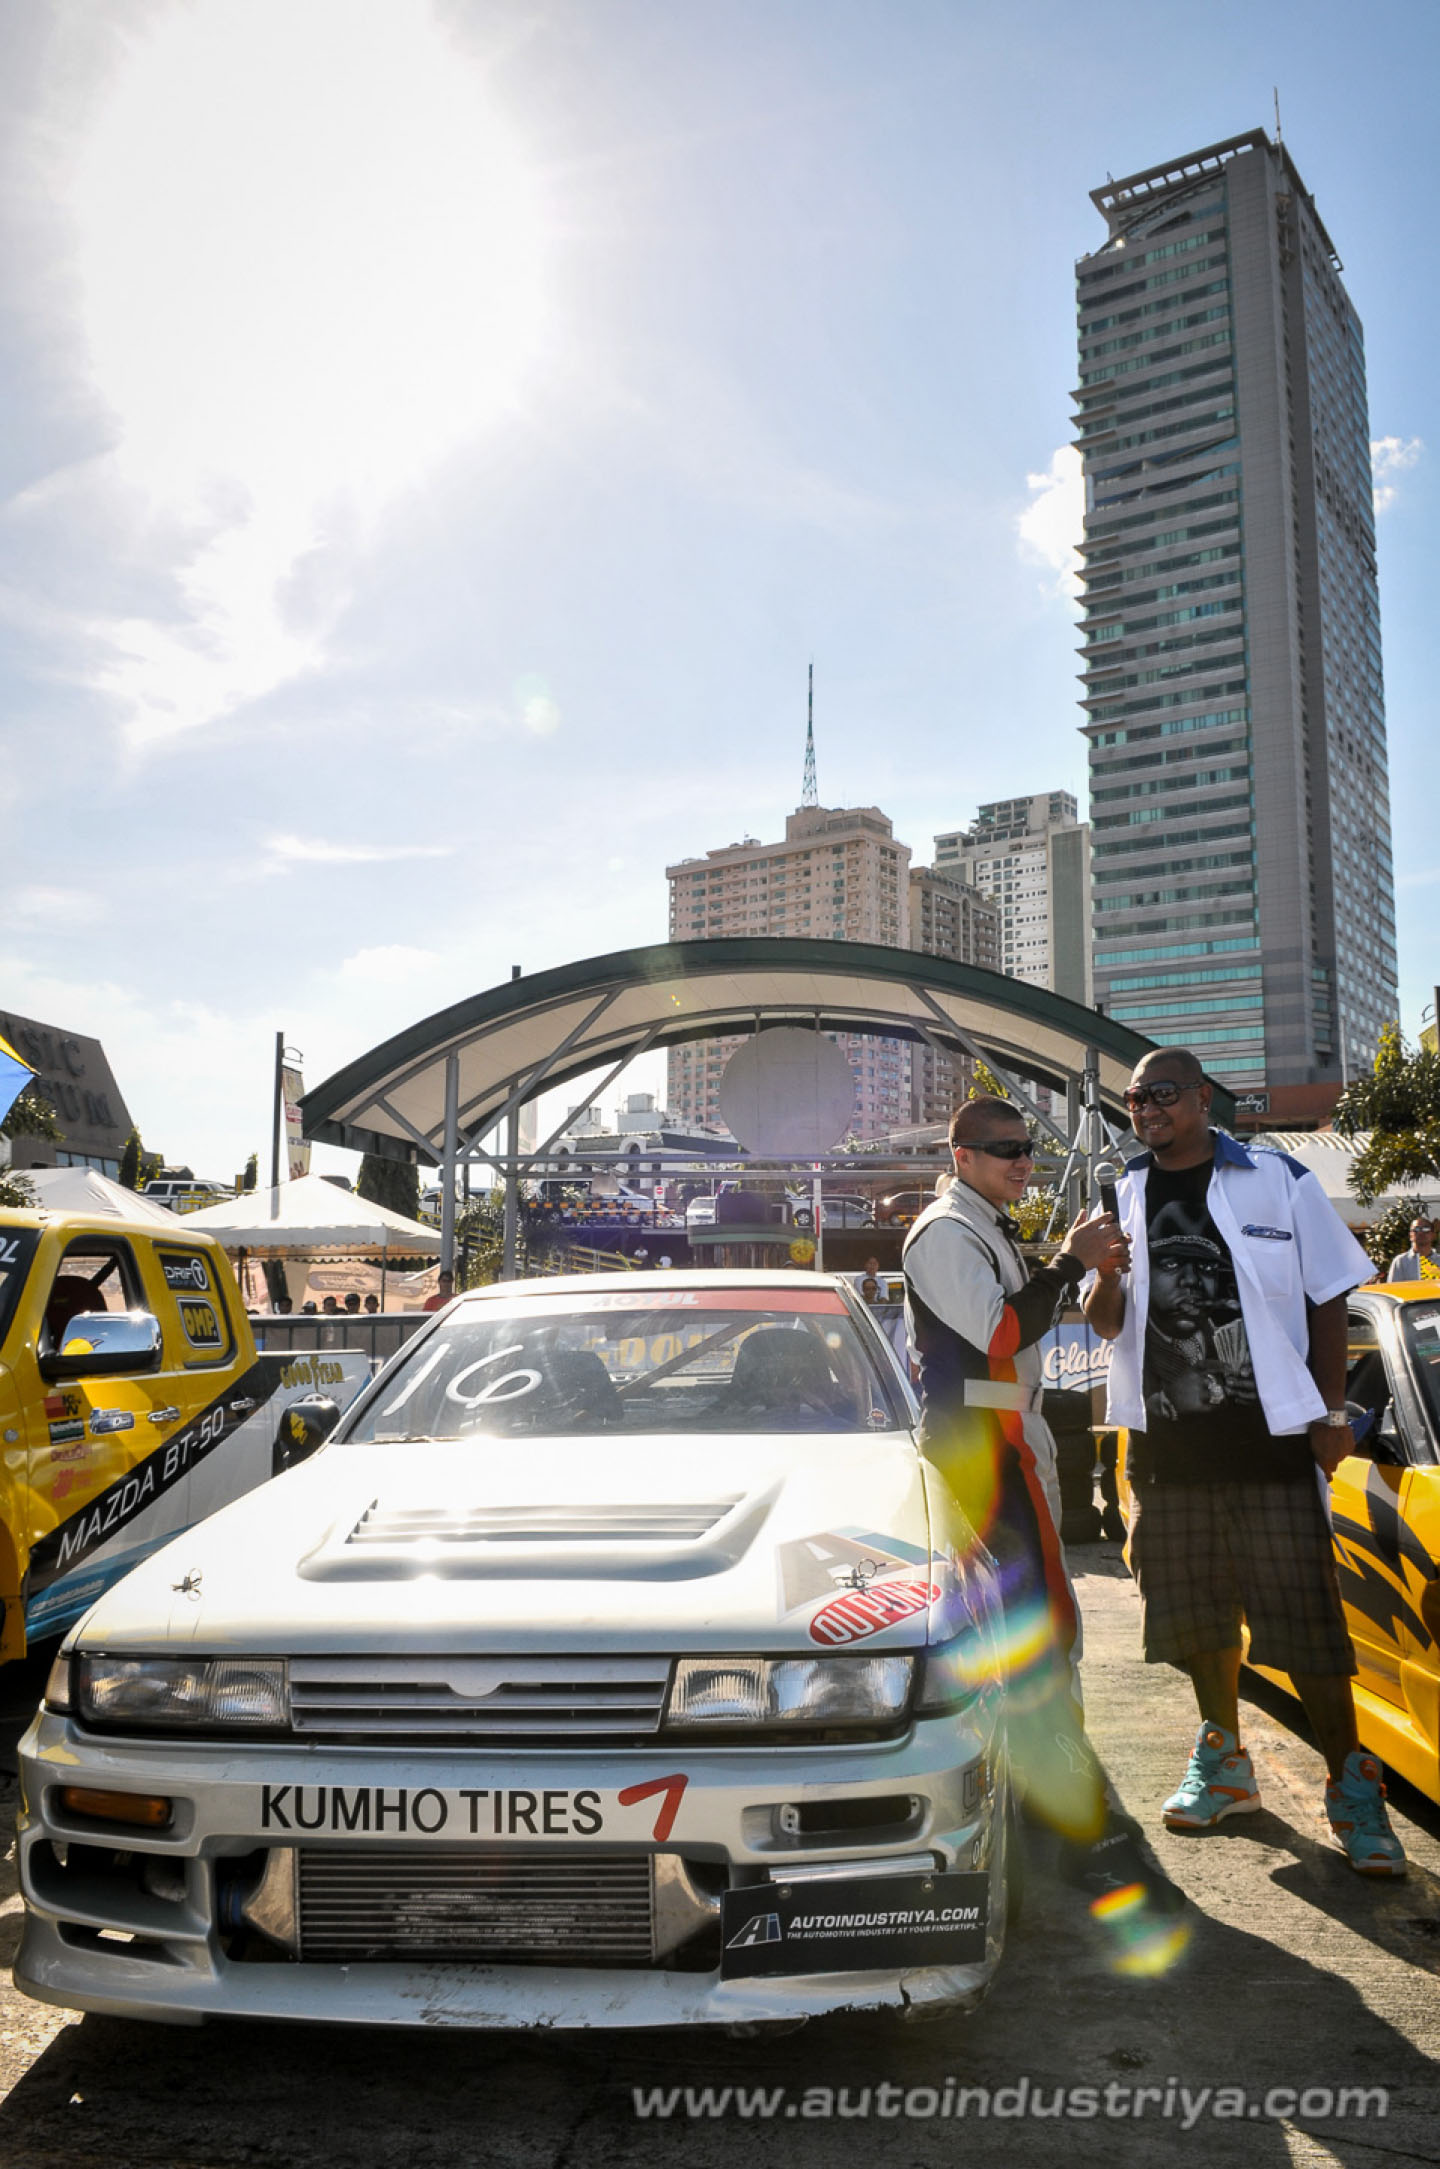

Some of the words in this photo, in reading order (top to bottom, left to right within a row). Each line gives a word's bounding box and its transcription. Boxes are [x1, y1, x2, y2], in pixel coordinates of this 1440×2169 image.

[56, 1465, 155, 1569] MAZDA
[163, 1406, 224, 1481] BT-50
[261, 1784, 449, 1834] KUMHO
[458, 1789, 603, 1836] TIRES
[786, 1930, 803, 1940] THE
[803, 1929, 856, 1939] AUTOMOTIVE
[856, 1927, 897, 1937] INDUSTRY
[897, 1926, 908, 1935] AT
[909, 1925, 931, 1934] YOUR
[789, 1906, 980, 1929] AUTOINDUSTRIYA.COM
